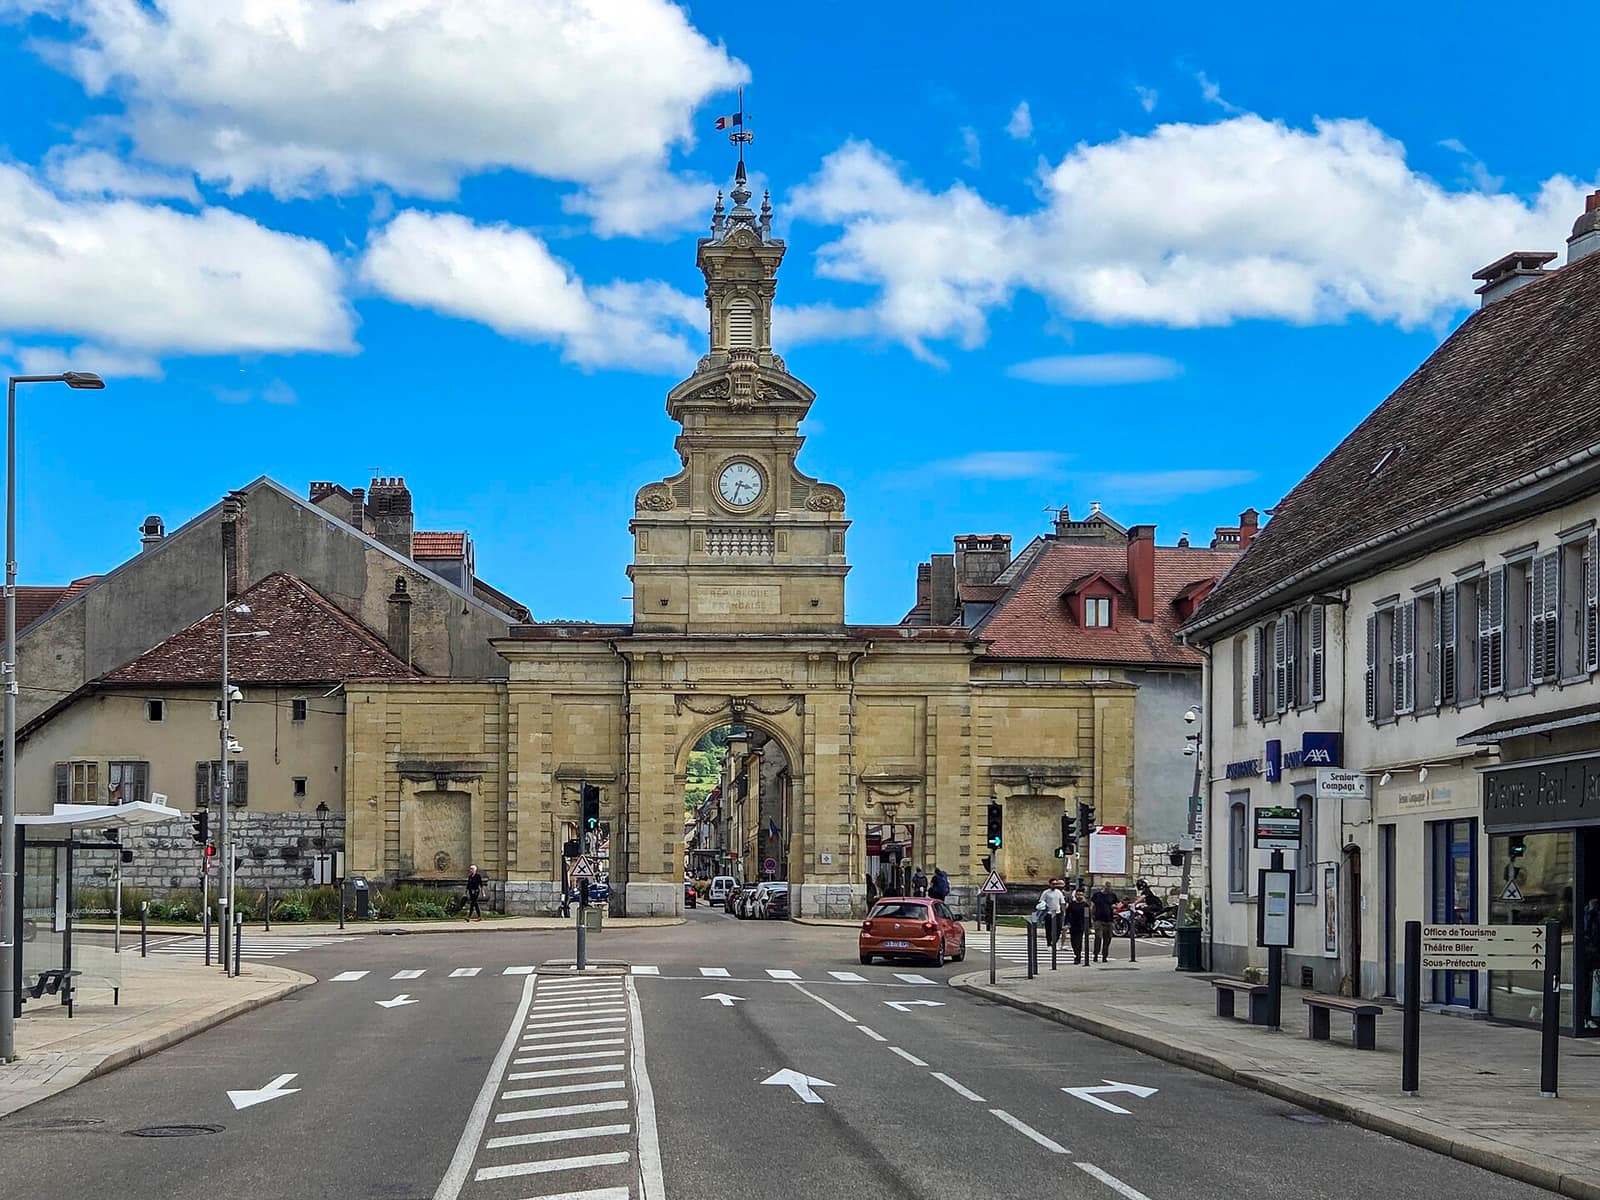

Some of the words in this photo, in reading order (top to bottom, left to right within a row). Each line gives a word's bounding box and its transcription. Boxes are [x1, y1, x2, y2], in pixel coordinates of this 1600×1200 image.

[1303, 748, 1331, 763] AXA
[1330, 772, 1357, 781] Senior
[1537, 766, 1568, 806] Paul
[1423, 927, 1447, 937] Office
[1448, 927, 1459, 937] de
[1460, 927, 1497, 937] Tourisme
[1423, 943, 1454, 952] Théâtre
[1423, 958, 1487, 968] Sous-Préfecture
